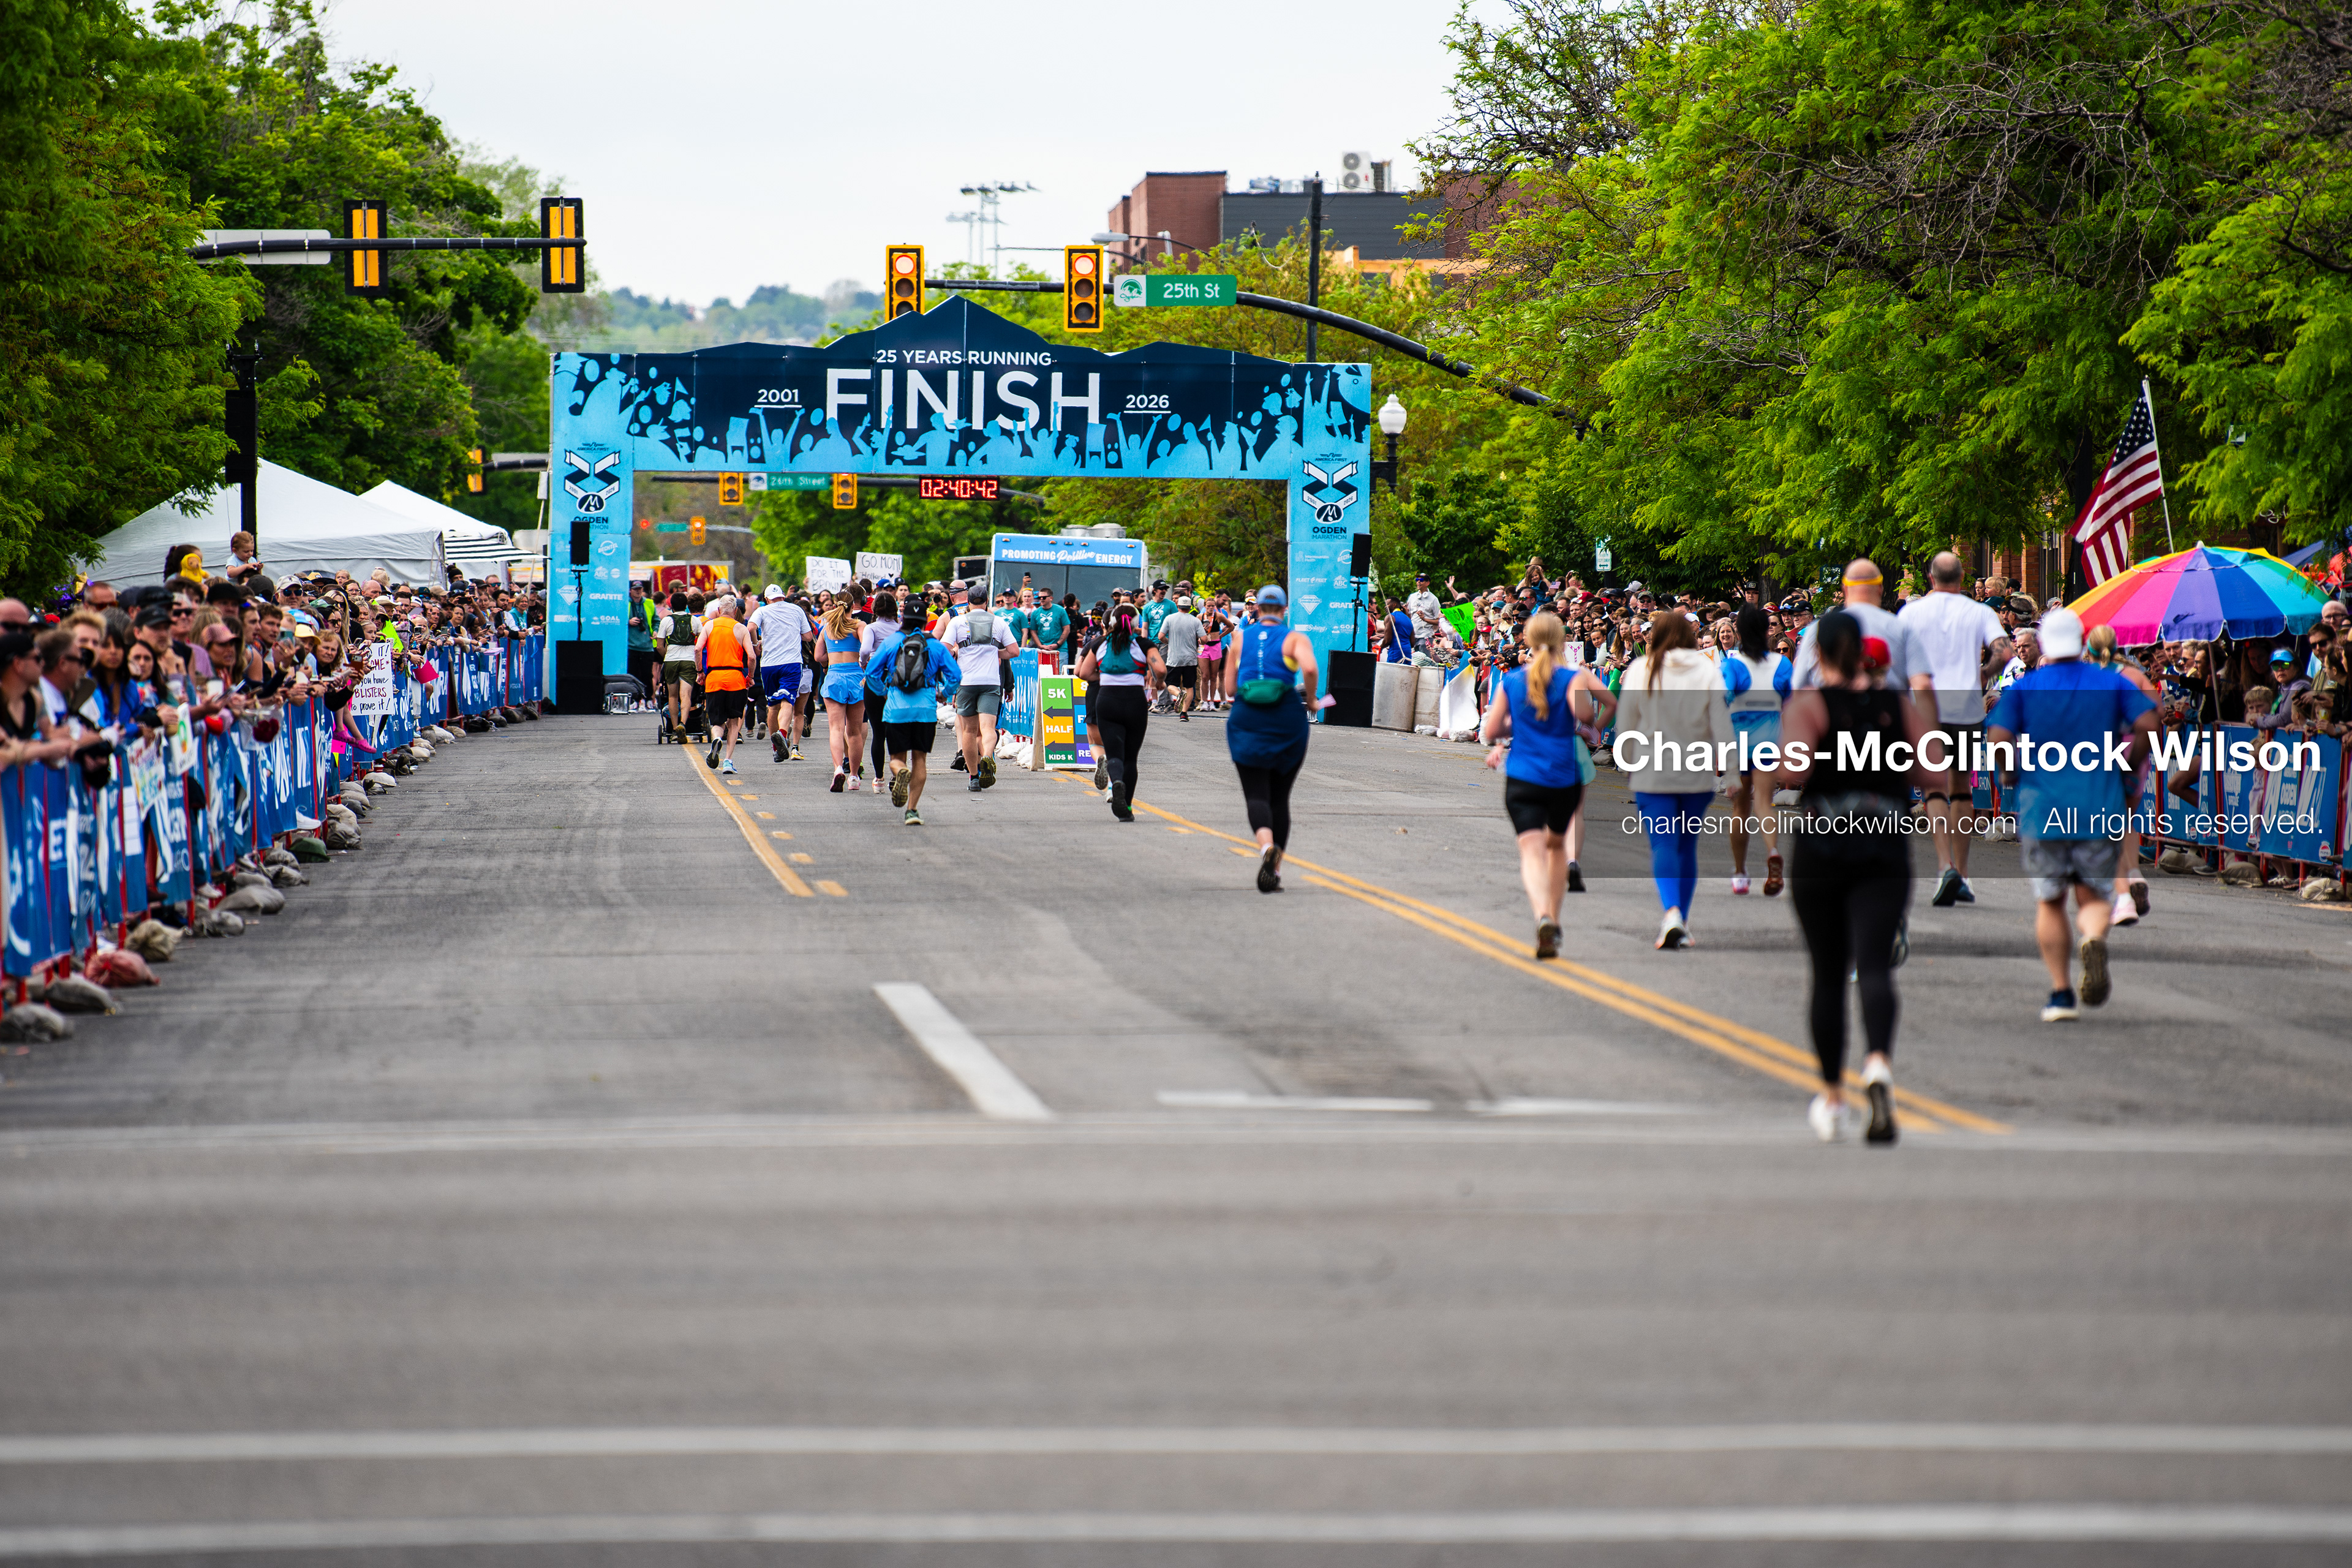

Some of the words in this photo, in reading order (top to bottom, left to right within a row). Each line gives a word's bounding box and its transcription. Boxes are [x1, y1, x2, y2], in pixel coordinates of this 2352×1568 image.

[1163, 282, 1199, 298] 25th
[1204, 282, 1220, 298] St
[876, 350, 897, 363] 25
[902, 350, 962, 363] YEARS
[968, 351, 1052, 366] RUNNING
[758, 389, 799, 403] 2001
[826, 368, 1100, 431] FINISH
[1126, 395, 1170, 409] 2026
[921, 479, 998, 499] 02:40:42
[812, 559, 823, 568] DO
[1002, 549, 1056, 560] PROMOTING
[1057, 549, 1096, 563] Positive
[1095, 553, 1133, 565] ENERGY
[812, 569, 827, 578] FOR
[378, 644, 390, 657] IT!
[360, 678, 372, 687] you
[373, 674, 388, 684] have
[355, 687, 386, 698] BLISTERS
[1048, 688, 1066, 699] 5K
[360, 702, 375, 714] prove
[378, 698, 390, 710] it!
